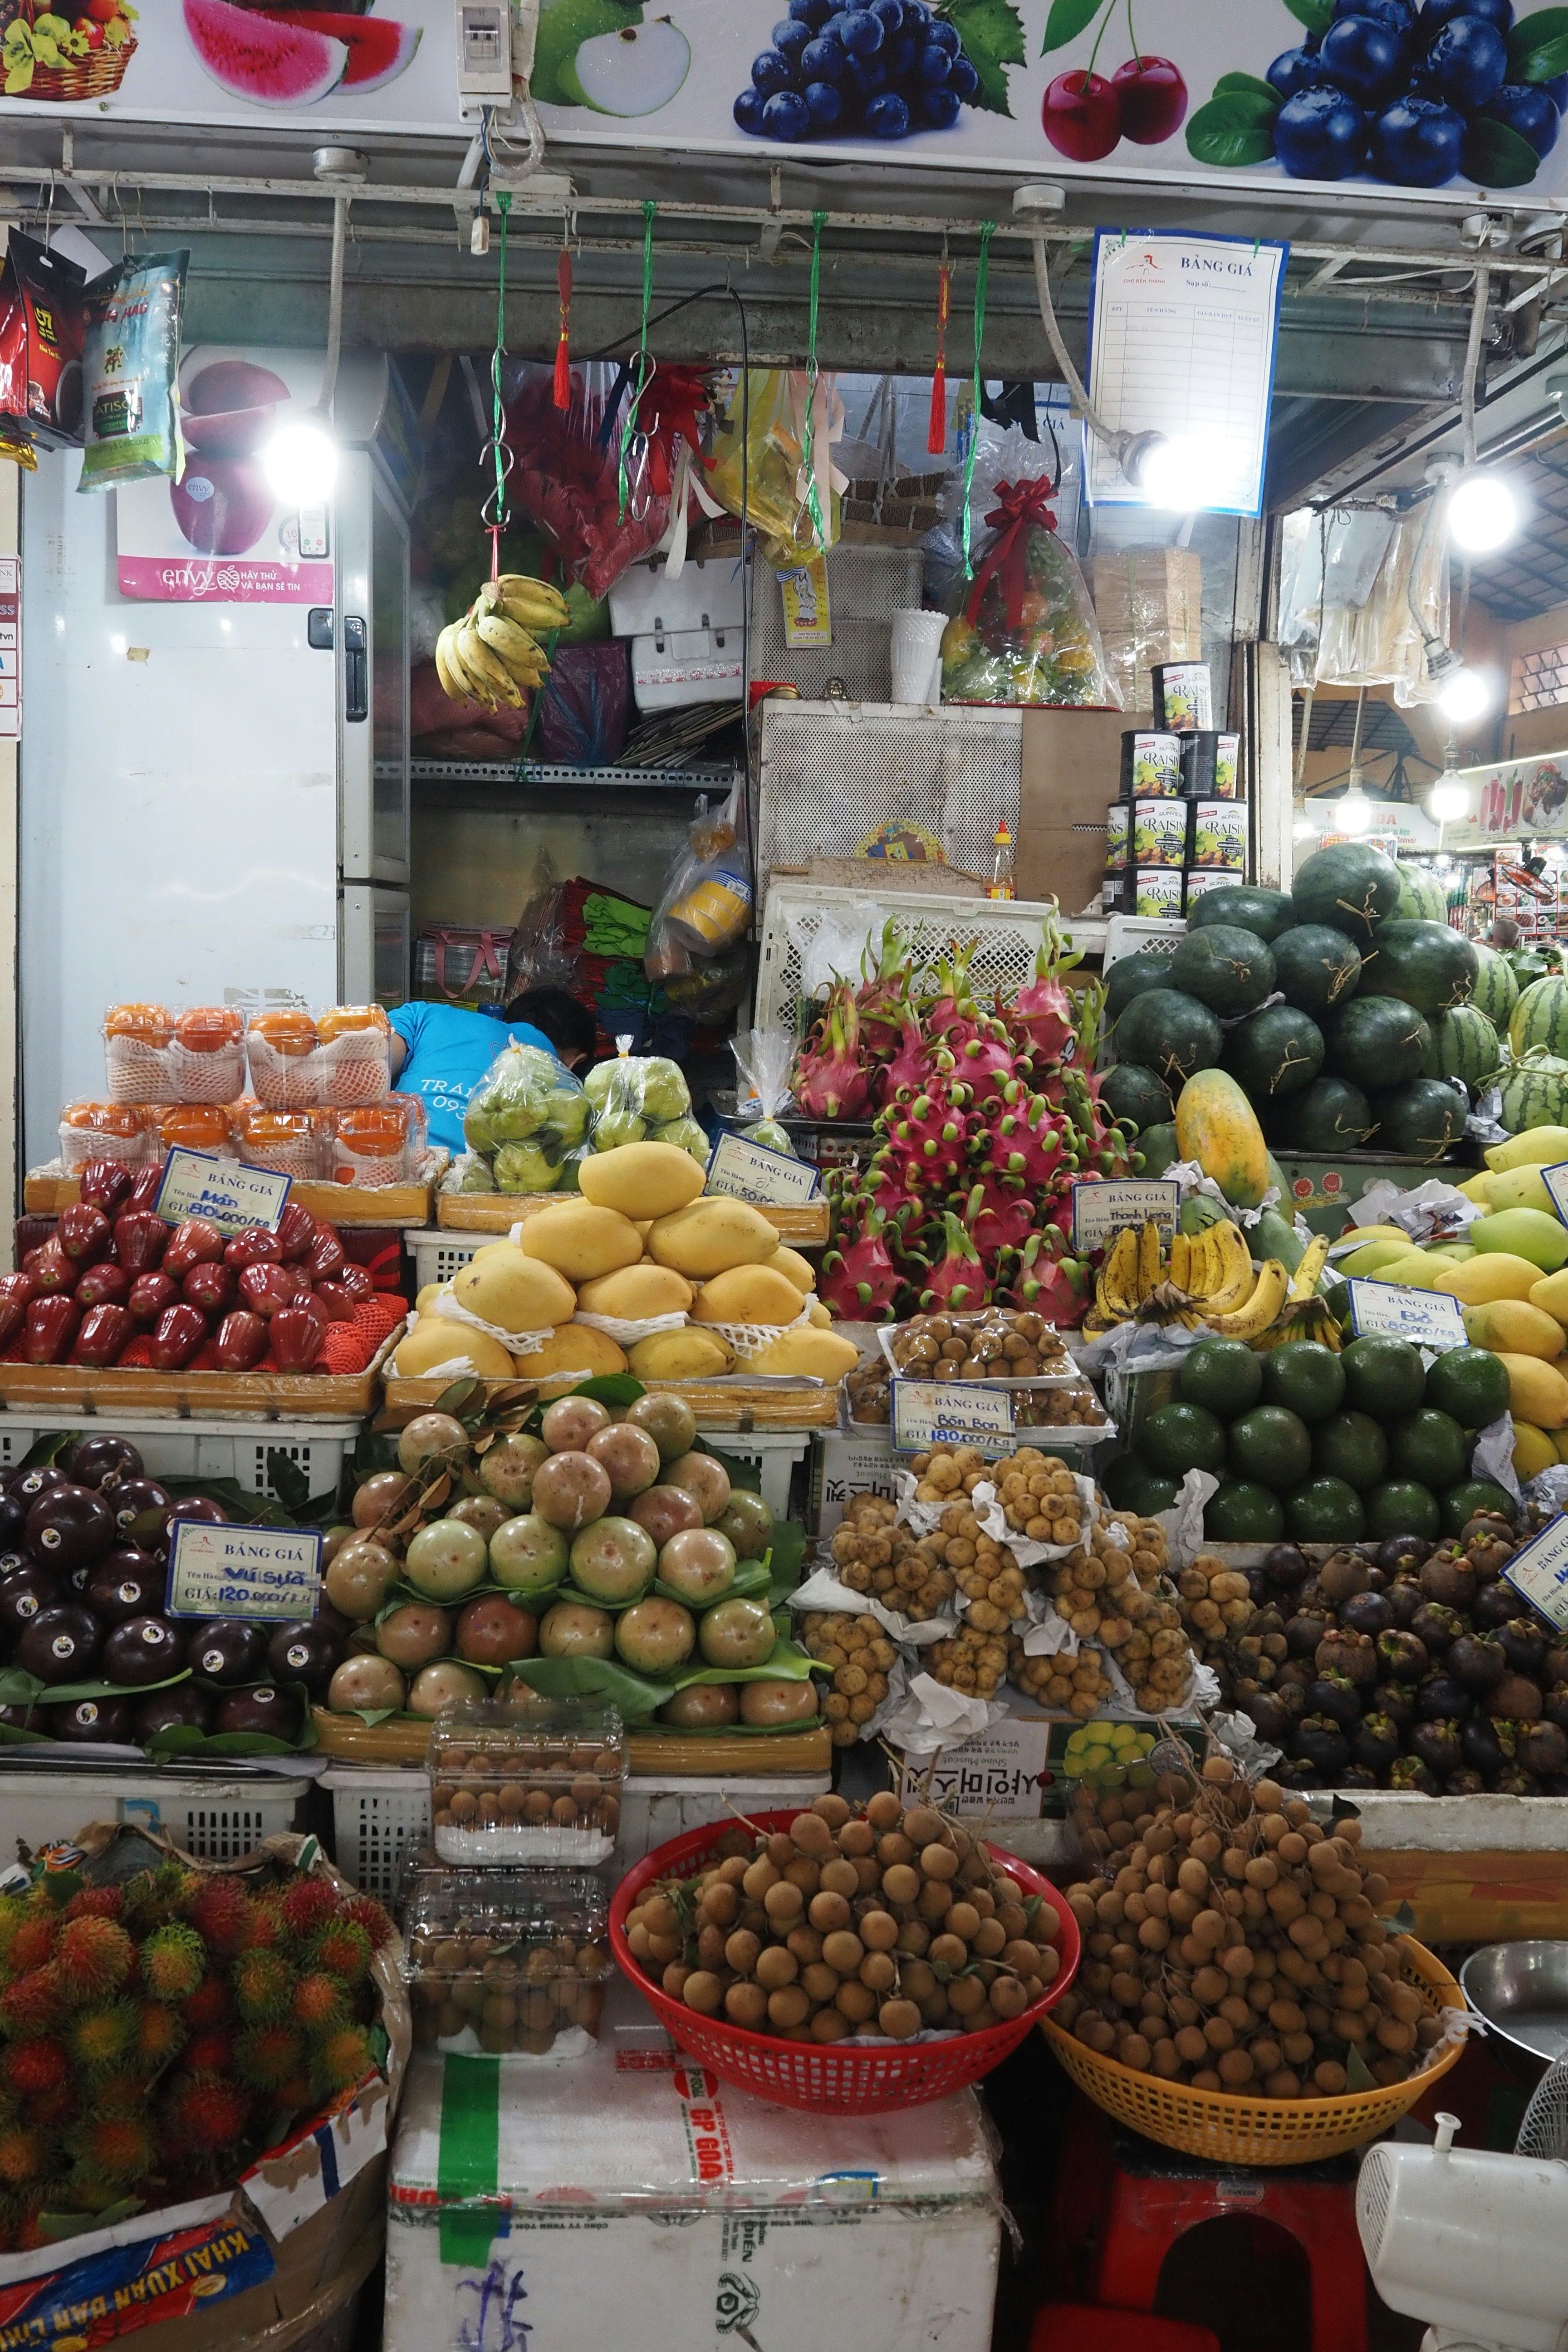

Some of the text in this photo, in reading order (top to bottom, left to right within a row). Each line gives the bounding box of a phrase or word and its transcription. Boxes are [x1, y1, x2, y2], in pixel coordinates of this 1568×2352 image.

[1181, 254, 1253, 277] BẢNG GIÁ
[1186, 279, 1200, 288] Sạp
[188, 483, 209, 496] envy
[162, 569, 277, 596] envy HÃY THỬ
[241, 580, 300, 592] VÀ BẠN SẼ TIN
[720, 1168, 745, 1183] Tên Hàng
[750, 1157, 803, 1186] BẢNG GIÁ
[173, 1188, 185, 1197] Tên
[208, 1172, 246, 1189] BẢNG
[249, 1185, 274, 1196] GIÁ
[1109, 1191, 1166, 1202] BẢNG GIÁ
[1387, 1295, 1421, 1308] BẢNG
[1425, 1303, 1446, 1312] GIÁ
[934, 1395, 1000, 1413] BẢNG GIÁ
[972, 1418, 1000, 1431] Bon
[225, 1542, 304, 1561] BẢNG GIÁ
[1537, 1545, 1563, 1570] BẢNG
[186, 1571, 202, 1579] Tên
[1542, 1584, 1563, 1603] Tên Hàng
[942, 1756, 1007, 1767] Shine Muscat
[184, 2230, 250, 2277] KHAI
